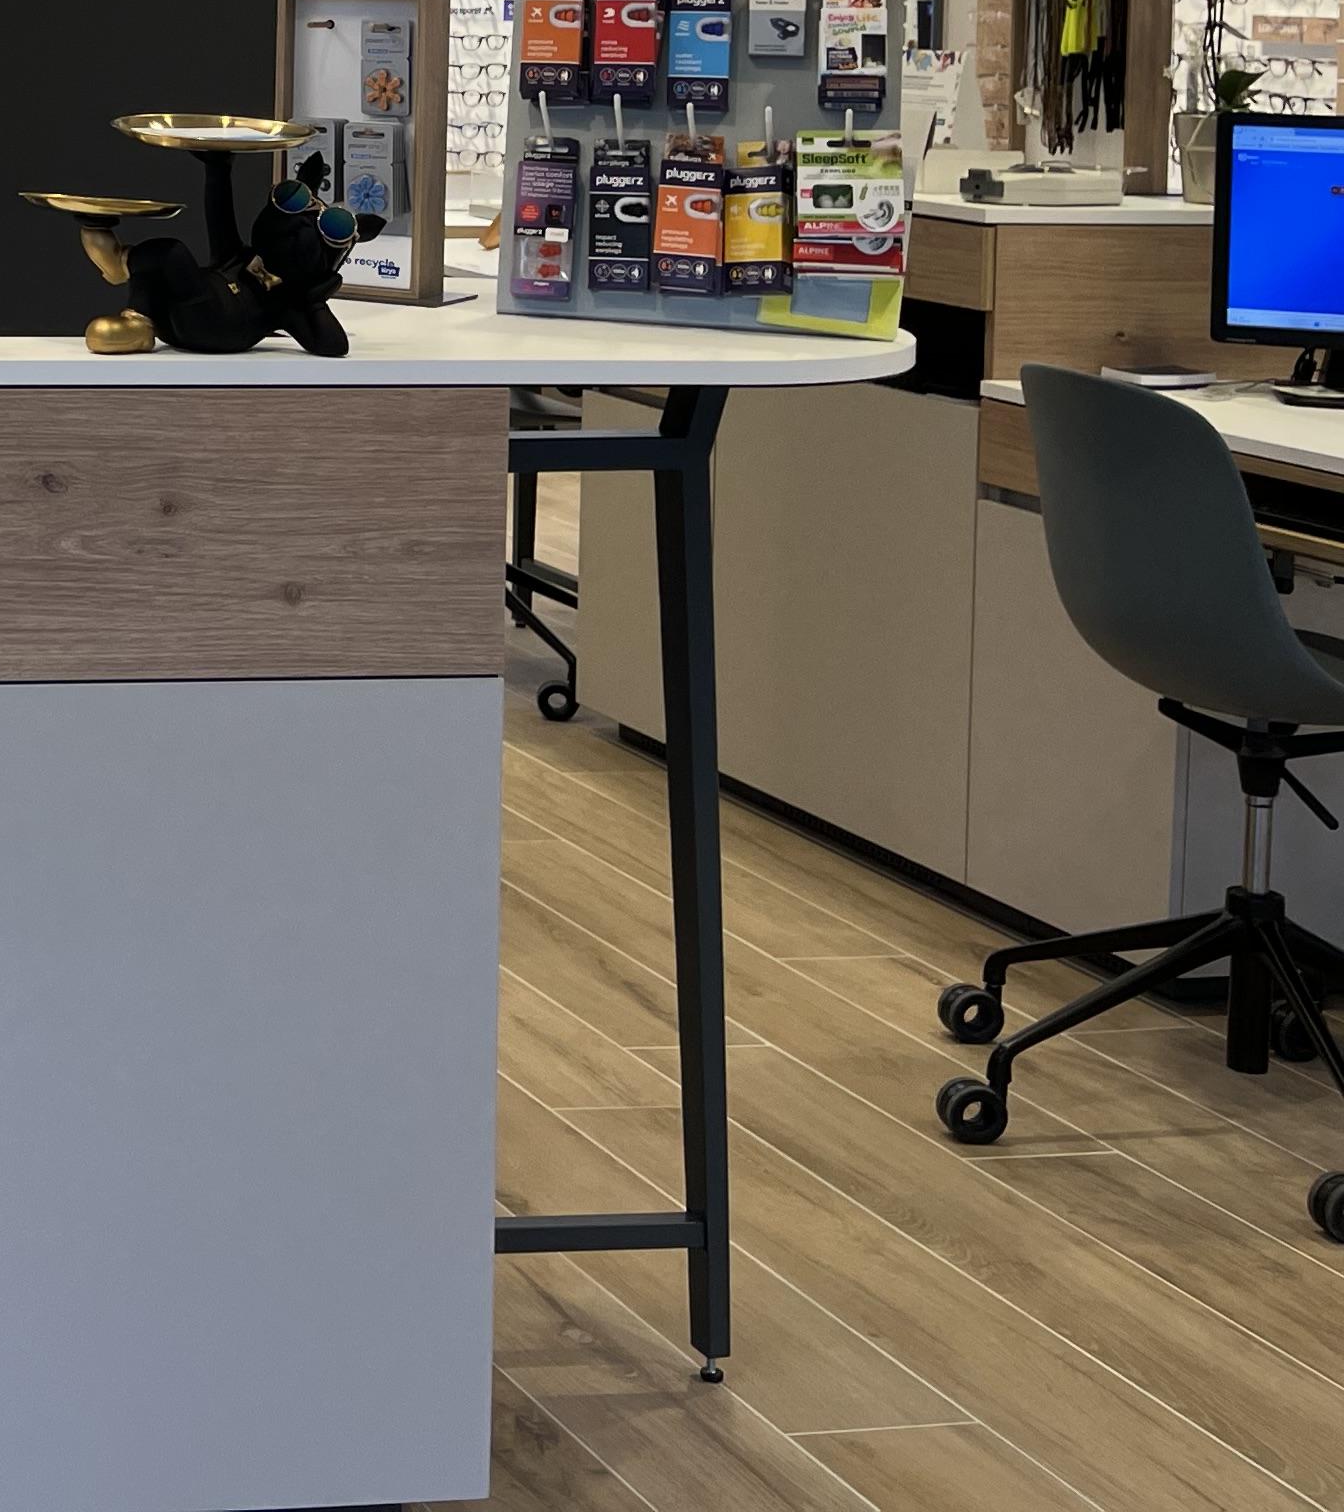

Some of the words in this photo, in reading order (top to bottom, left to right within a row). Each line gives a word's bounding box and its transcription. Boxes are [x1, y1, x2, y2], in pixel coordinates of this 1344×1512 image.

[802, 153, 866, 166] SleepSoft
[595, 174, 644, 187] pluggerz
[665, 167, 716, 182] pluggerz
[730, 175, 777, 188] pluggerz
[798, 246, 830, 255] ALPINE
[354, 256, 395, 269] recycle
